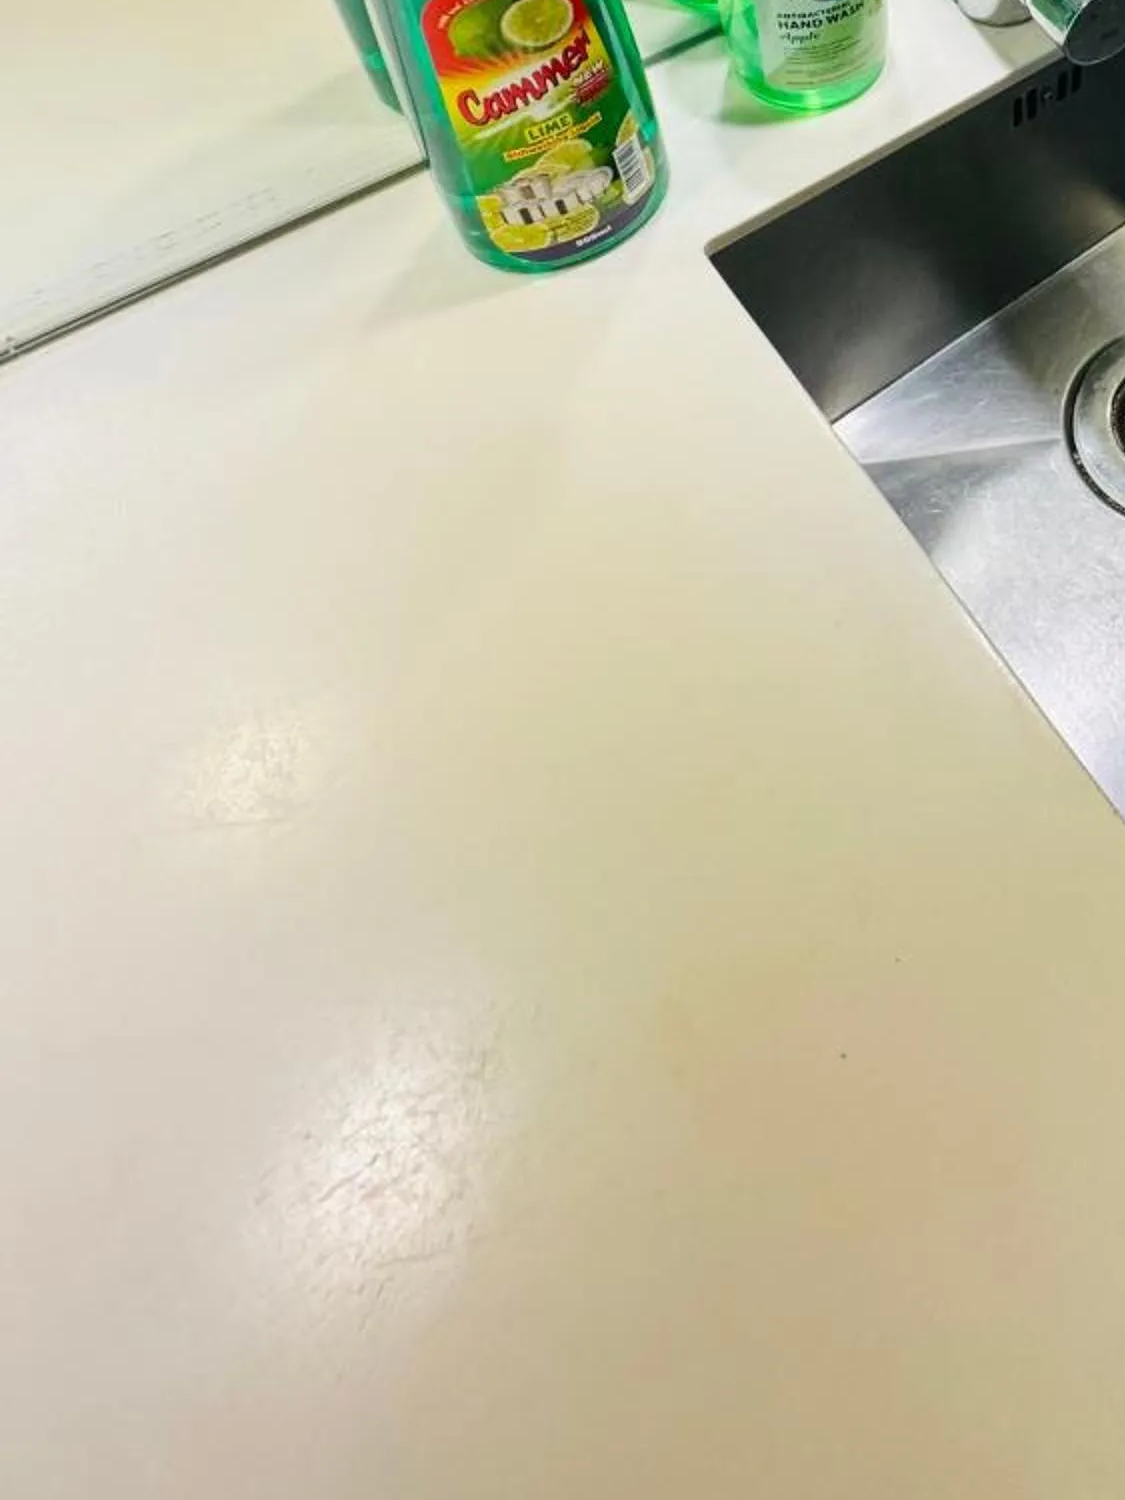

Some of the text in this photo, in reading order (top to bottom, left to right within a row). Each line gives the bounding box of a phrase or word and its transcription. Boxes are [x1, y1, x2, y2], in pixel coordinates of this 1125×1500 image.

[777, 0, 865, 29] HAND WASH
[526, 115, 570, 141] LIME
